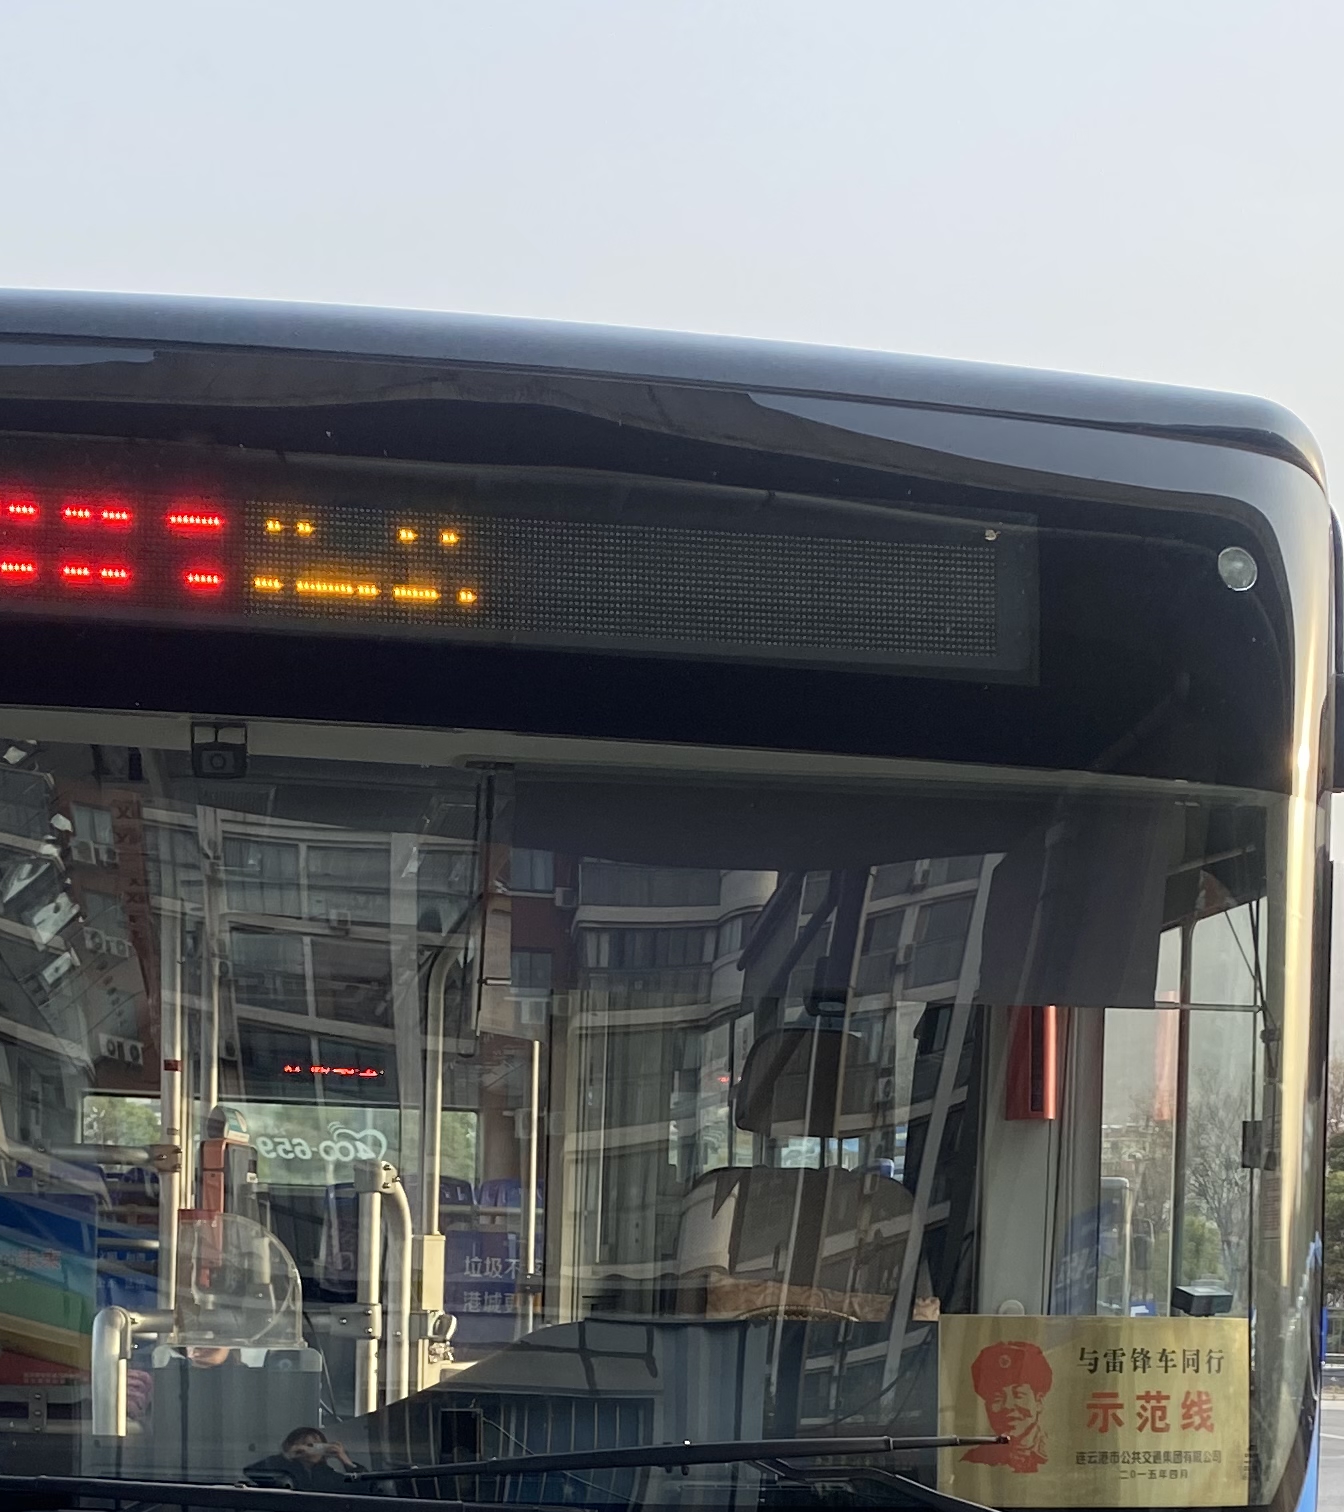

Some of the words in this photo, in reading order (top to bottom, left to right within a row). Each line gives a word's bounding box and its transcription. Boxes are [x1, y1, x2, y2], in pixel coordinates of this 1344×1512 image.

[1076, 1346, 1225, 1375] 与雷锋车同行
[1086, 1390, 1215, 1433] 示范线
